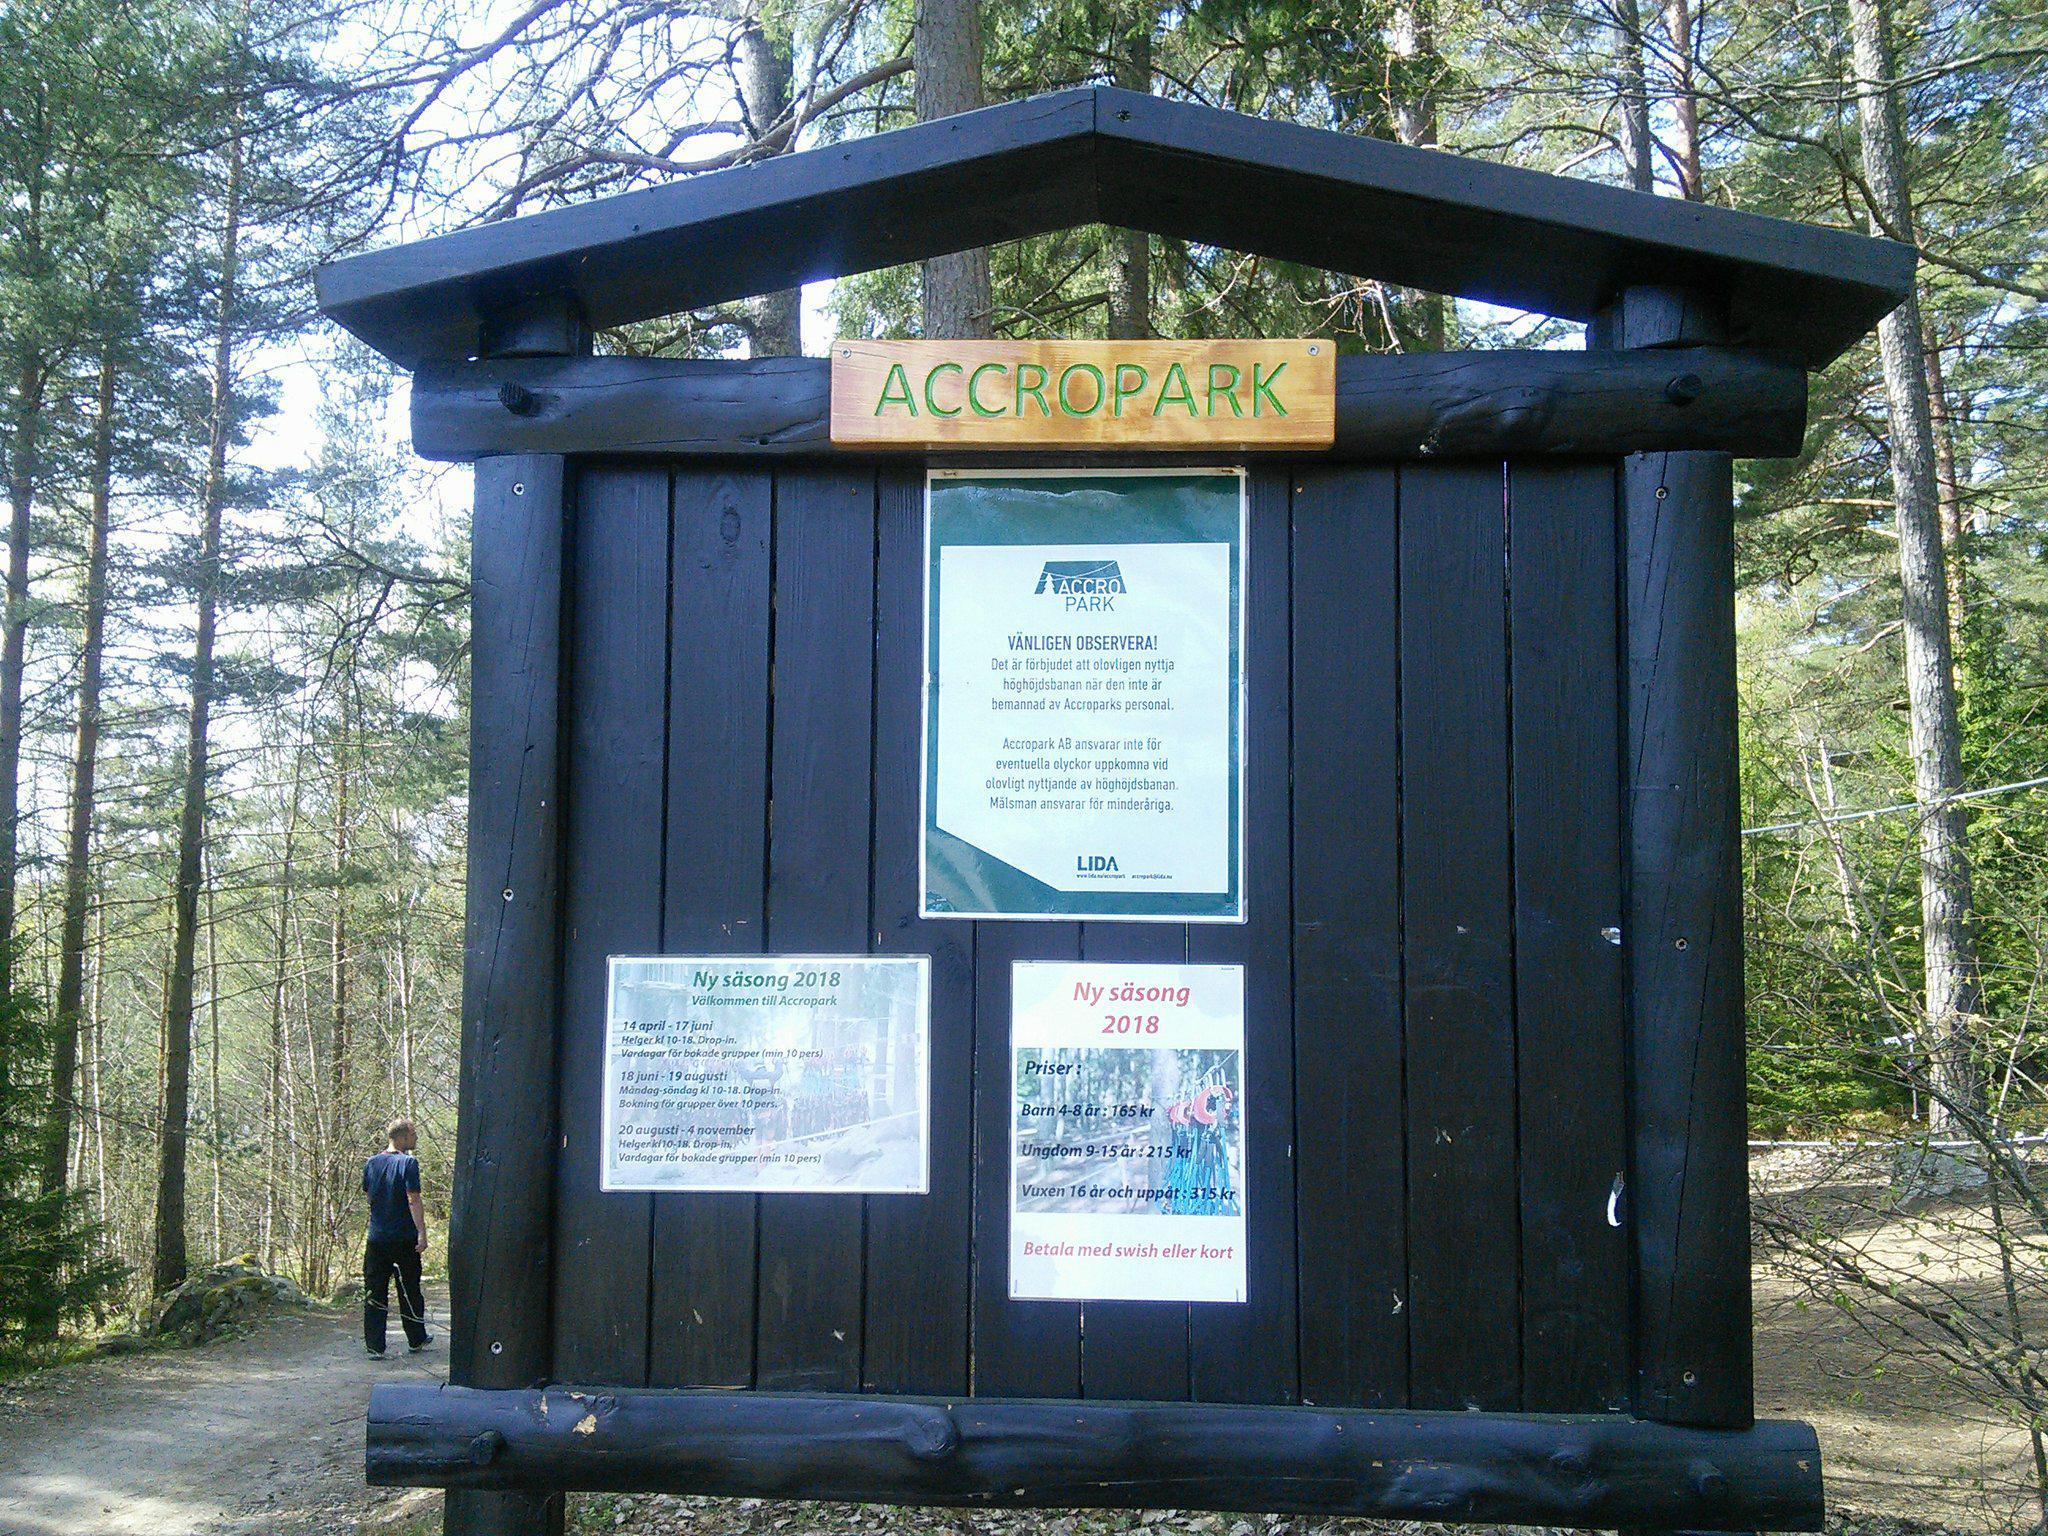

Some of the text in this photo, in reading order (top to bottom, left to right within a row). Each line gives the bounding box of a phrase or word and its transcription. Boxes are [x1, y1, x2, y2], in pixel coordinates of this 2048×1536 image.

[874, 361, 1288, 419] ACCROPARK
[1059, 579, 1120, 594] ACCRO
[1065, 596, 1115, 612] PARK
[1008, 632, 1158, 651] VÄNLIGEN OBSERVERA!
[992, 658, 1174, 672] Det är förbjudet att olovligen nyttja
[1003, 678, 1162, 693] höghöjdsbanan när den inte är
[992, 698, 1174, 712] bemannad av Accroparks personal.
[1003, 737, 1162, 751] Accropark AB ansvarar inte för
[996, 758, 1168, 772] eventuella olyckor uppkomna vid
[986, 777, 1178, 791] olovligt nyttjande av höghöjdsbanan.
[990, 797, 1174, 812] Målsman ansvarar för minderåriga.
[1077, 856, 1118, 871] LIDA
[693, 971, 840, 992] Ny säsong 2018
[692, 995, 837, 1008] Välkommen till Accropark
[1073, 982, 1191, 1007] Ny säsong
[623, 1021, 636, 1030] 14
[639, 1020, 665, 1033] april
[675, 1021, 687, 1031] 17
[689, 1020, 714, 1033] juni
[1102, 1015, 1159, 1034] 2018
[621, 1035, 737, 1046] Helger kl 10-18. Drop-in.
[621, 1048, 823, 1060] Vardagar för bokade grupper (min 10 pers)
[1025, 1061, 1074, 1075] Priser
[621, 1071, 633, 1081] 18
[635, 1071, 658, 1083] juni
[669, 1071, 682, 1081] 19
[685, 1071, 727, 1083] augusti
[619, 1085, 781, 1097] Måndag-söndag kl 10-18. Drop-in.
[619, 1099, 778, 1111] Bokning för grupper över 10 pers.
[1022, 1105, 1055, 1117] Barn
[1058, 1105, 1081, 1117] 4-8
[1085, 1105, 1100, 1117] år
[1112, 1105, 1136, 1117] 165
[1140, 1105, 1155, 1117] kr
[619, 1126, 633, 1135] 20
[636, 1125, 679, 1137] augusti
[688, 1126, 694, 1135] 4
[697, 1125, 756, 1135] november
[619, 1139, 732, 1151] Helger kl 10-18. Drop-in.
[619, 1153, 821, 1165] Vardagar för bokade grupper (min 10 pers)
[1022, 1145, 1082, 1161] Ungdom
[1085, 1146, 1117, 1158] 9-15
[1121, 1145, 1136, 1158] år
[1146, 1146, 1172, 1158] 215
[1176, 1146, 1192, 1159] kr
[1022, 1186, 1065, 1197] Vuxen
[1069, 1186, 1086, 1197] 16
[1089, 1186, 1105, 1198] år
[1108, 1186, 1134, 1199] och
[1137, 1187, 1179, 1203] uppåt
[1190, 1188, 1217, 1200] 315
[1220, 1188, 1235, 1200] kr
[1024, 1242, 1233, 1259] Betala med swish eller kort
